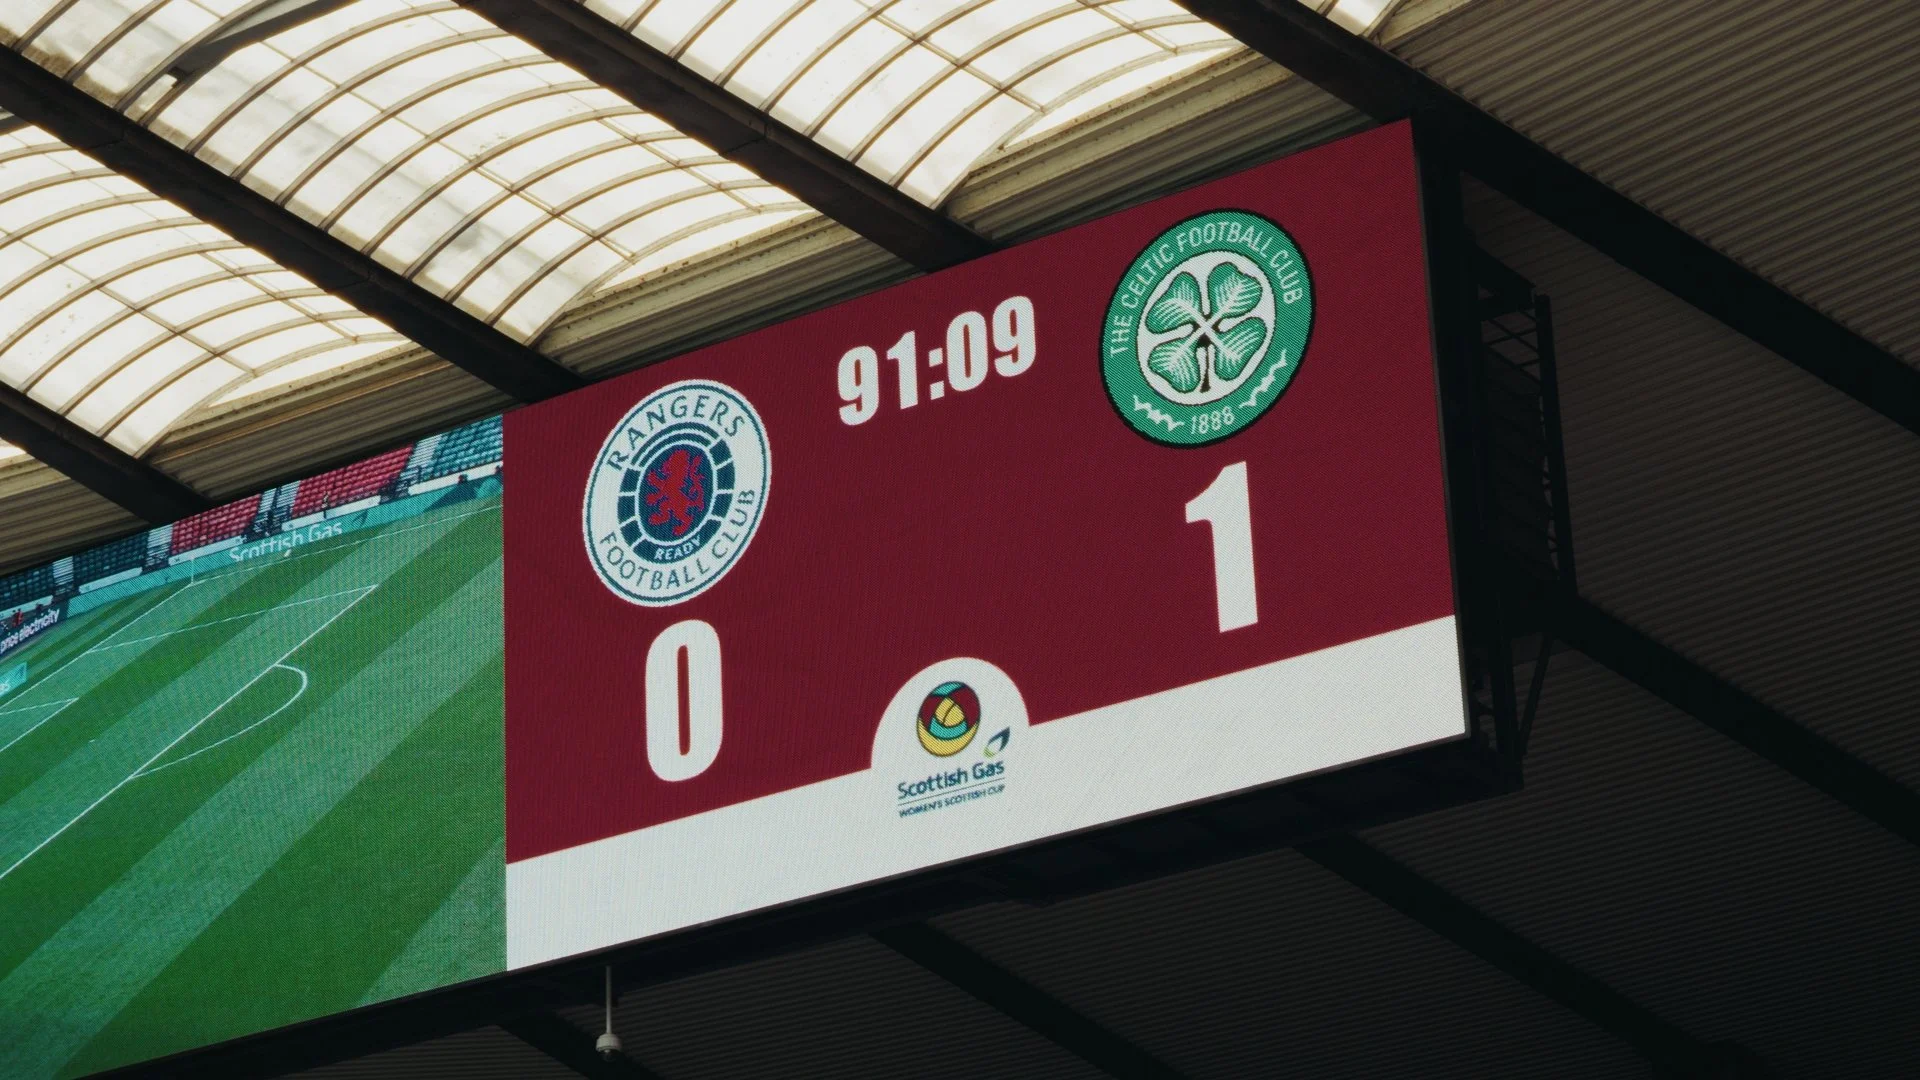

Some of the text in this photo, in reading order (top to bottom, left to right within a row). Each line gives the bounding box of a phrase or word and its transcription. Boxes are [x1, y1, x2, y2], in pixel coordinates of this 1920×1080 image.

[1109, 221, 1303, 357] THE CELTIC FOOTBALL CLUB
[837, 296, 1036, 425] 91:09
[606, 395, 745, 471] RANGERS
[1191, 407, 1235, 434] 1888
[308, 522, 343, 542] Gas
[600, 489, 755, 590] FOOTBALL CLUB
[653, 535, 701, 560] READY
[1185, 461, 1258, 633] 1
[645, 619, 723, 782] 0
[898, 761, 1005, 799] Scottish Gas
[899, 784, 1006, 818] WOMEN'S SCOTTISH CUP
